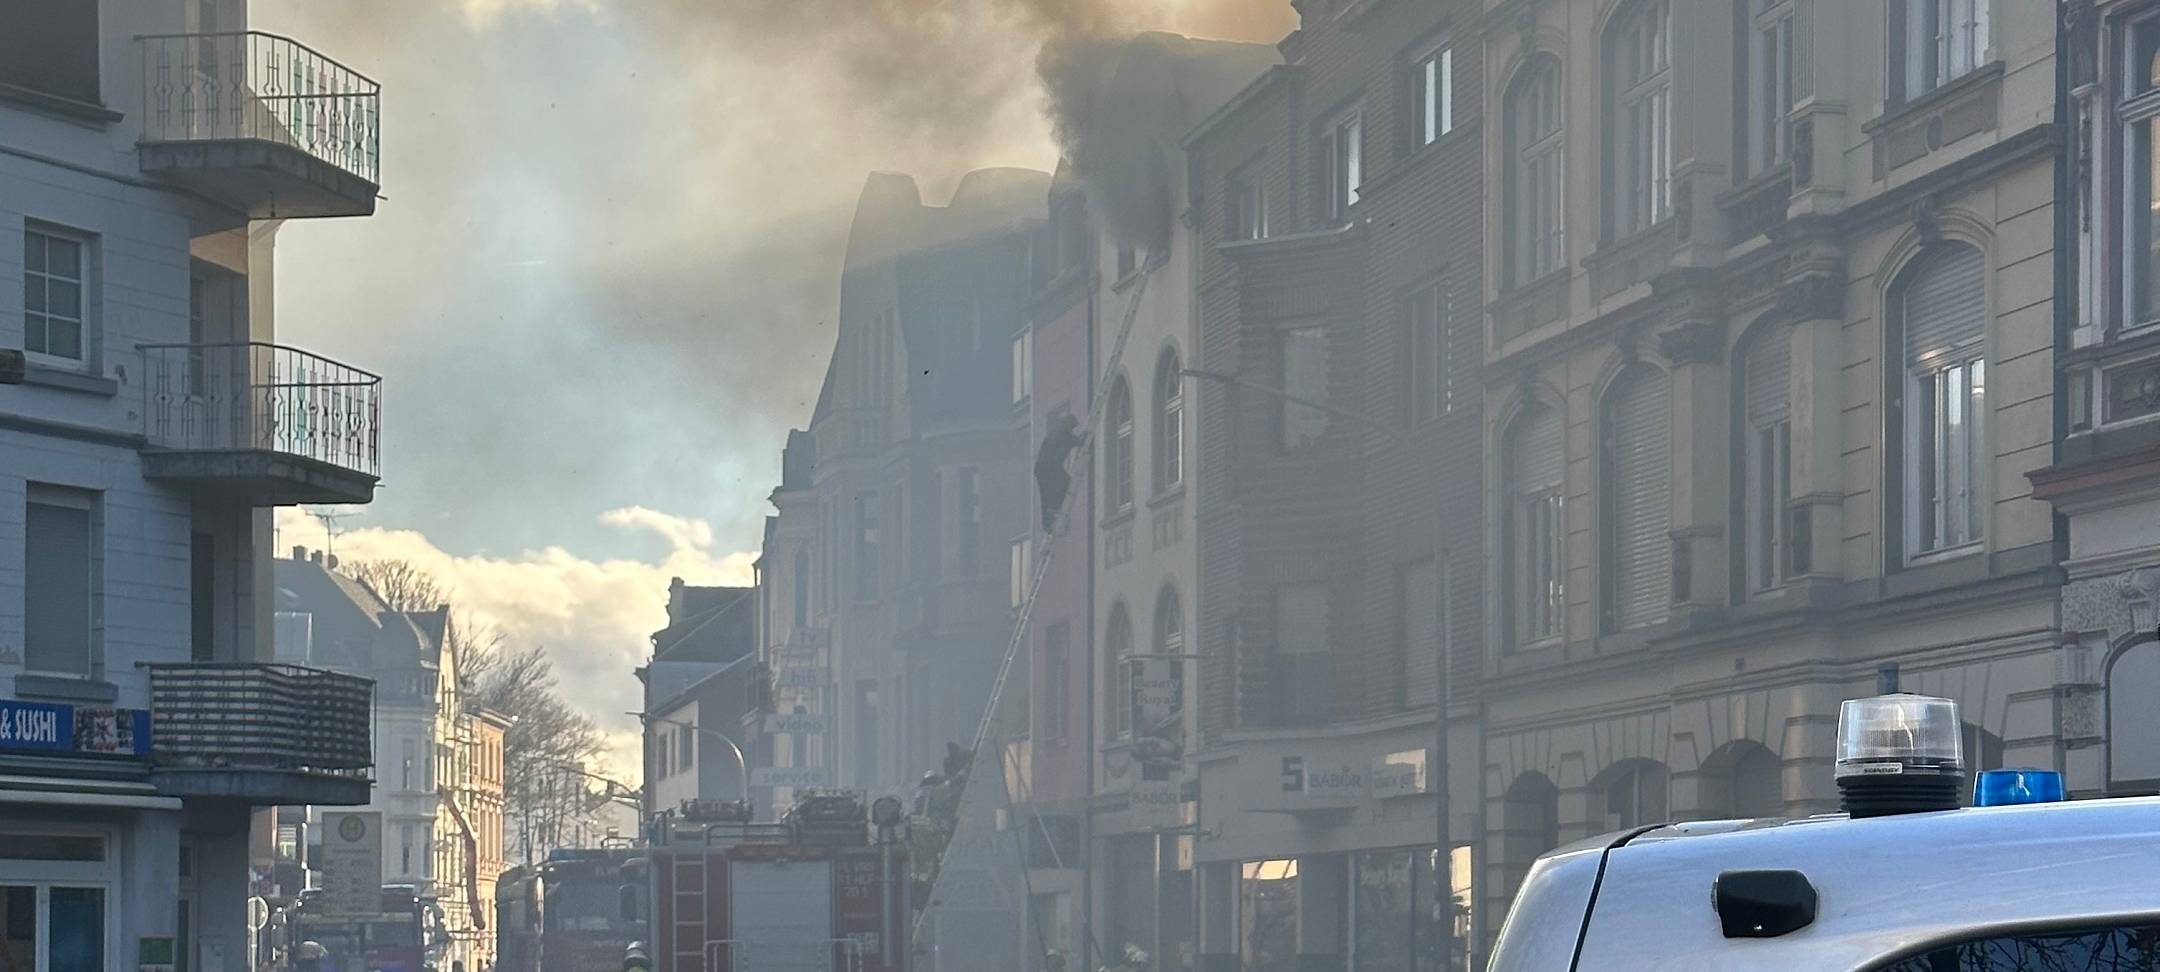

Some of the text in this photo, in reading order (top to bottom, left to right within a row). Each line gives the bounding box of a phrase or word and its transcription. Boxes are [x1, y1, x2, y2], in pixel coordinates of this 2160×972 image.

[1, 707, 57, 742] & SUSHI
[776, 714, 822, 730] video
